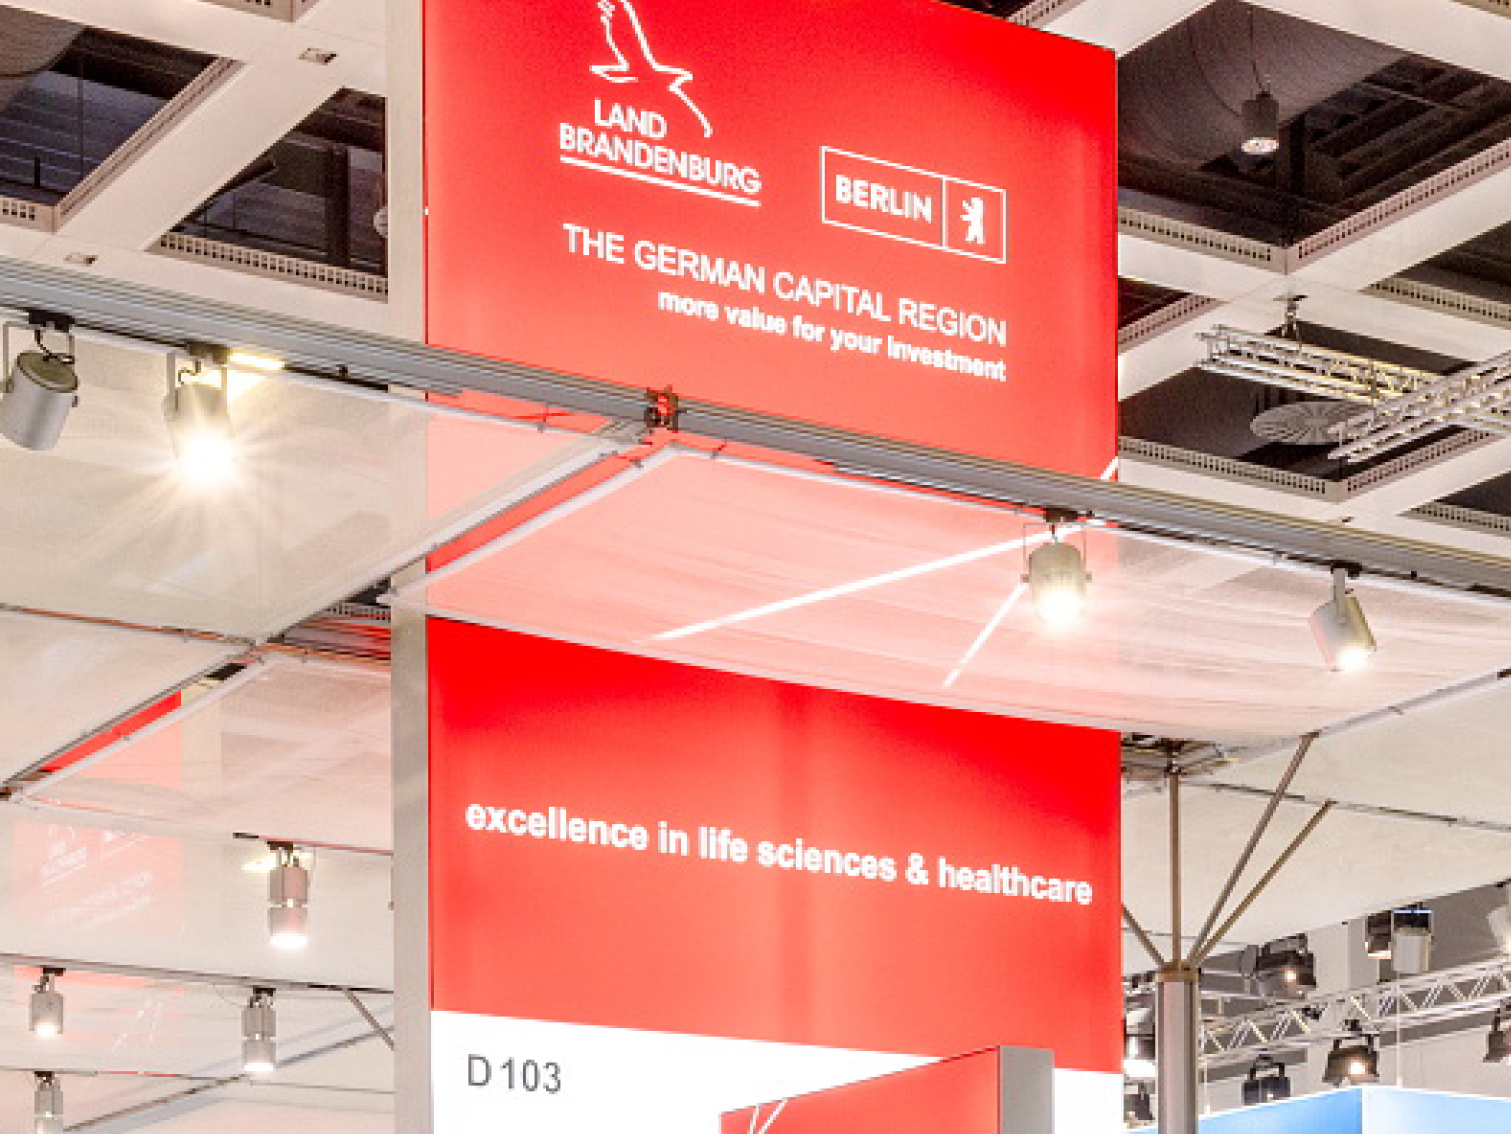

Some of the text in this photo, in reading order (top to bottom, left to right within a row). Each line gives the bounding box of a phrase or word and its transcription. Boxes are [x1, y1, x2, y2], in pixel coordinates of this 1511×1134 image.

[594, 99, 667, 139] LAND
[559, 122, 762, 195] BRANDENBURG
[834, 173, 933, 224] BERLIN
[562, 222, 1007, 347] THE GERMAN CAPITAL REGION
[658, 289, 721, 321] more
[725, 301, 788, 337] value
[792, 314, 824, 342] for
[830, 326, 883, 356] your
[466, 801, 1093, 905] excellence in life sciences & healthcare
[468, 1053, 562, 1094] D 103
